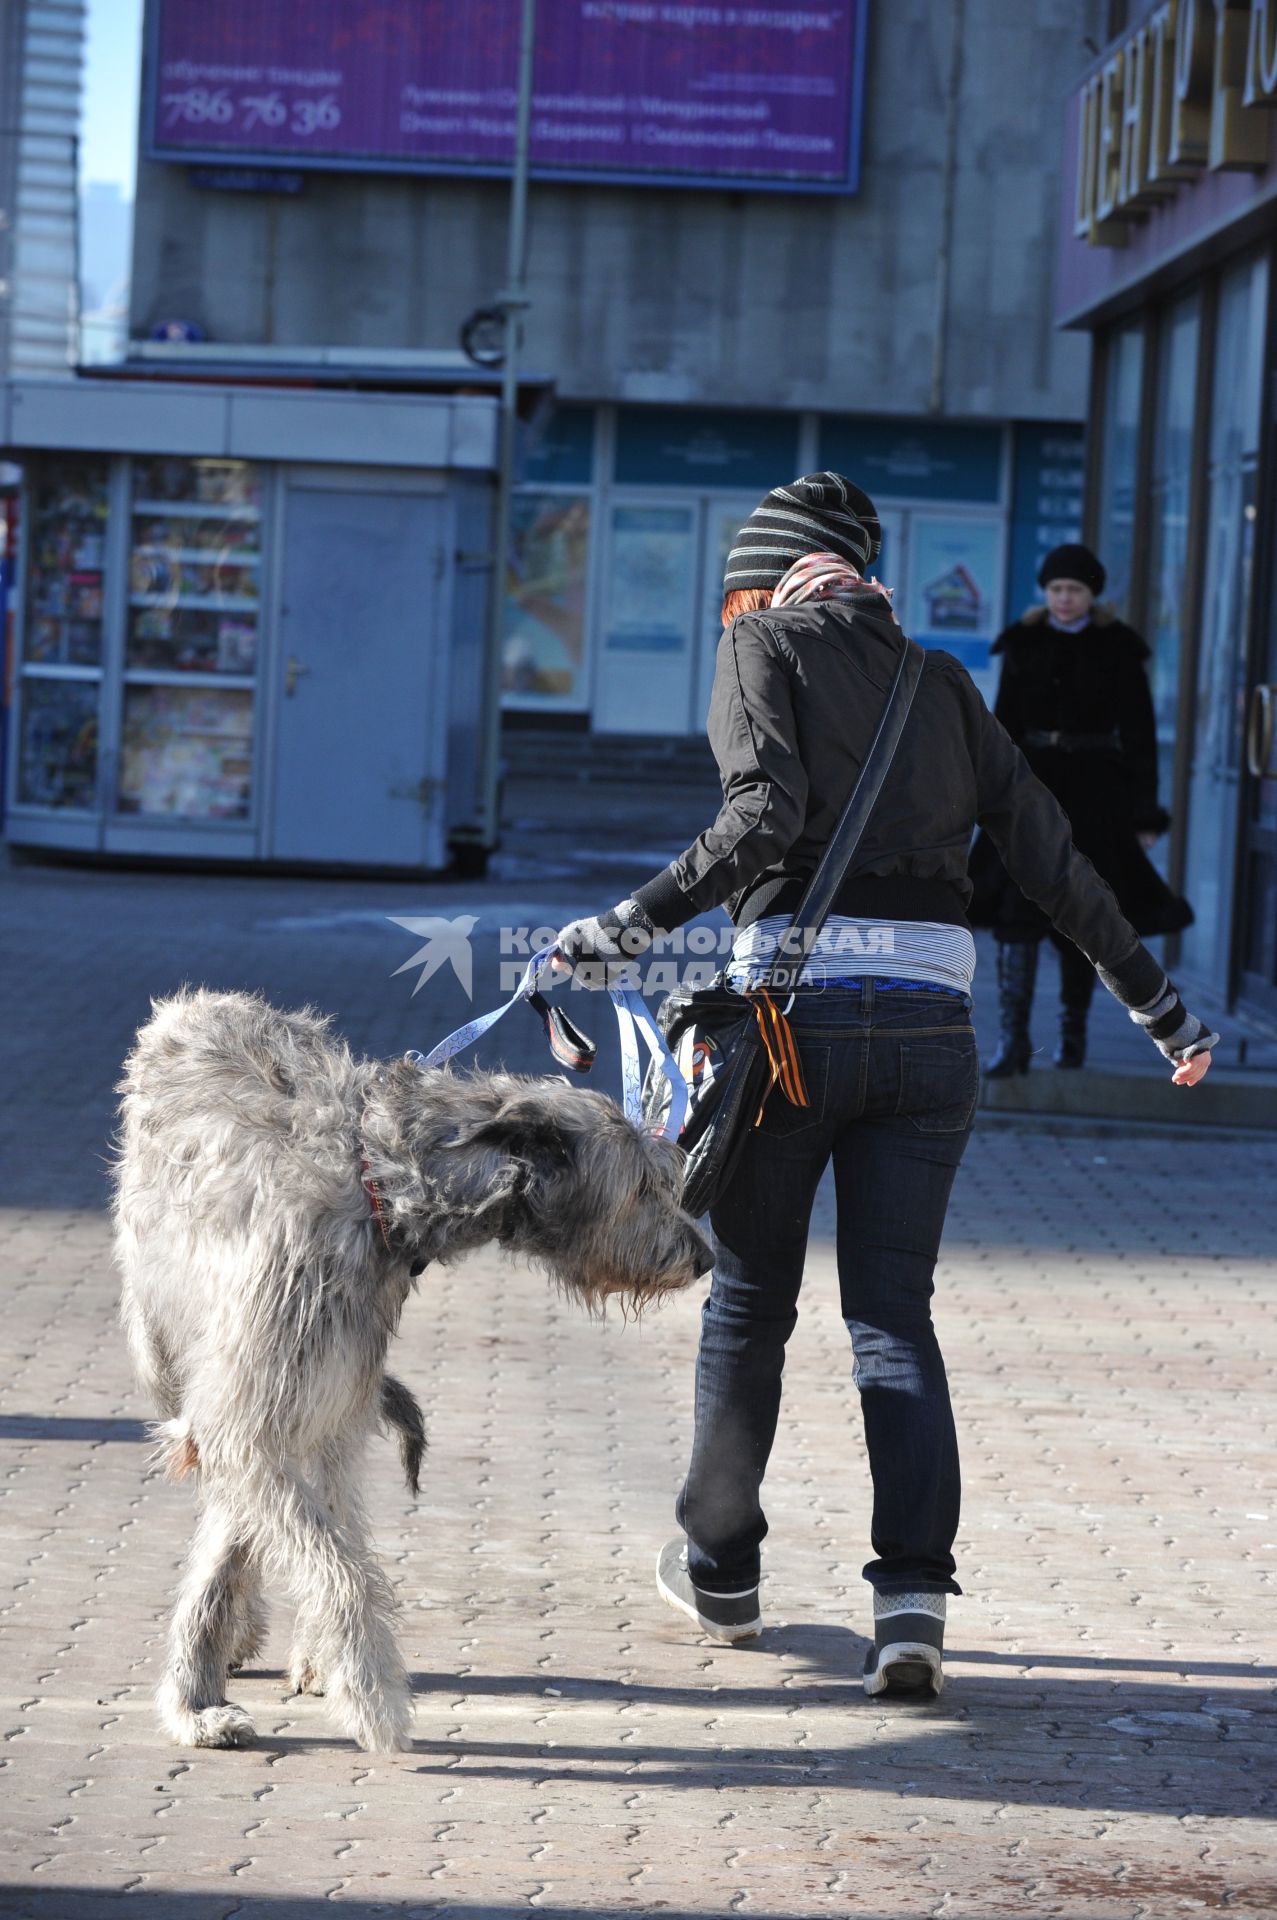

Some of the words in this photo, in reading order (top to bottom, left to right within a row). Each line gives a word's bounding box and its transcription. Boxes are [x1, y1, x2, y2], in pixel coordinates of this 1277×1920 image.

[162, 87, 234, 128] 786
[240, 91, 287, 131] 76
[291, 94, 342, 136] 36
